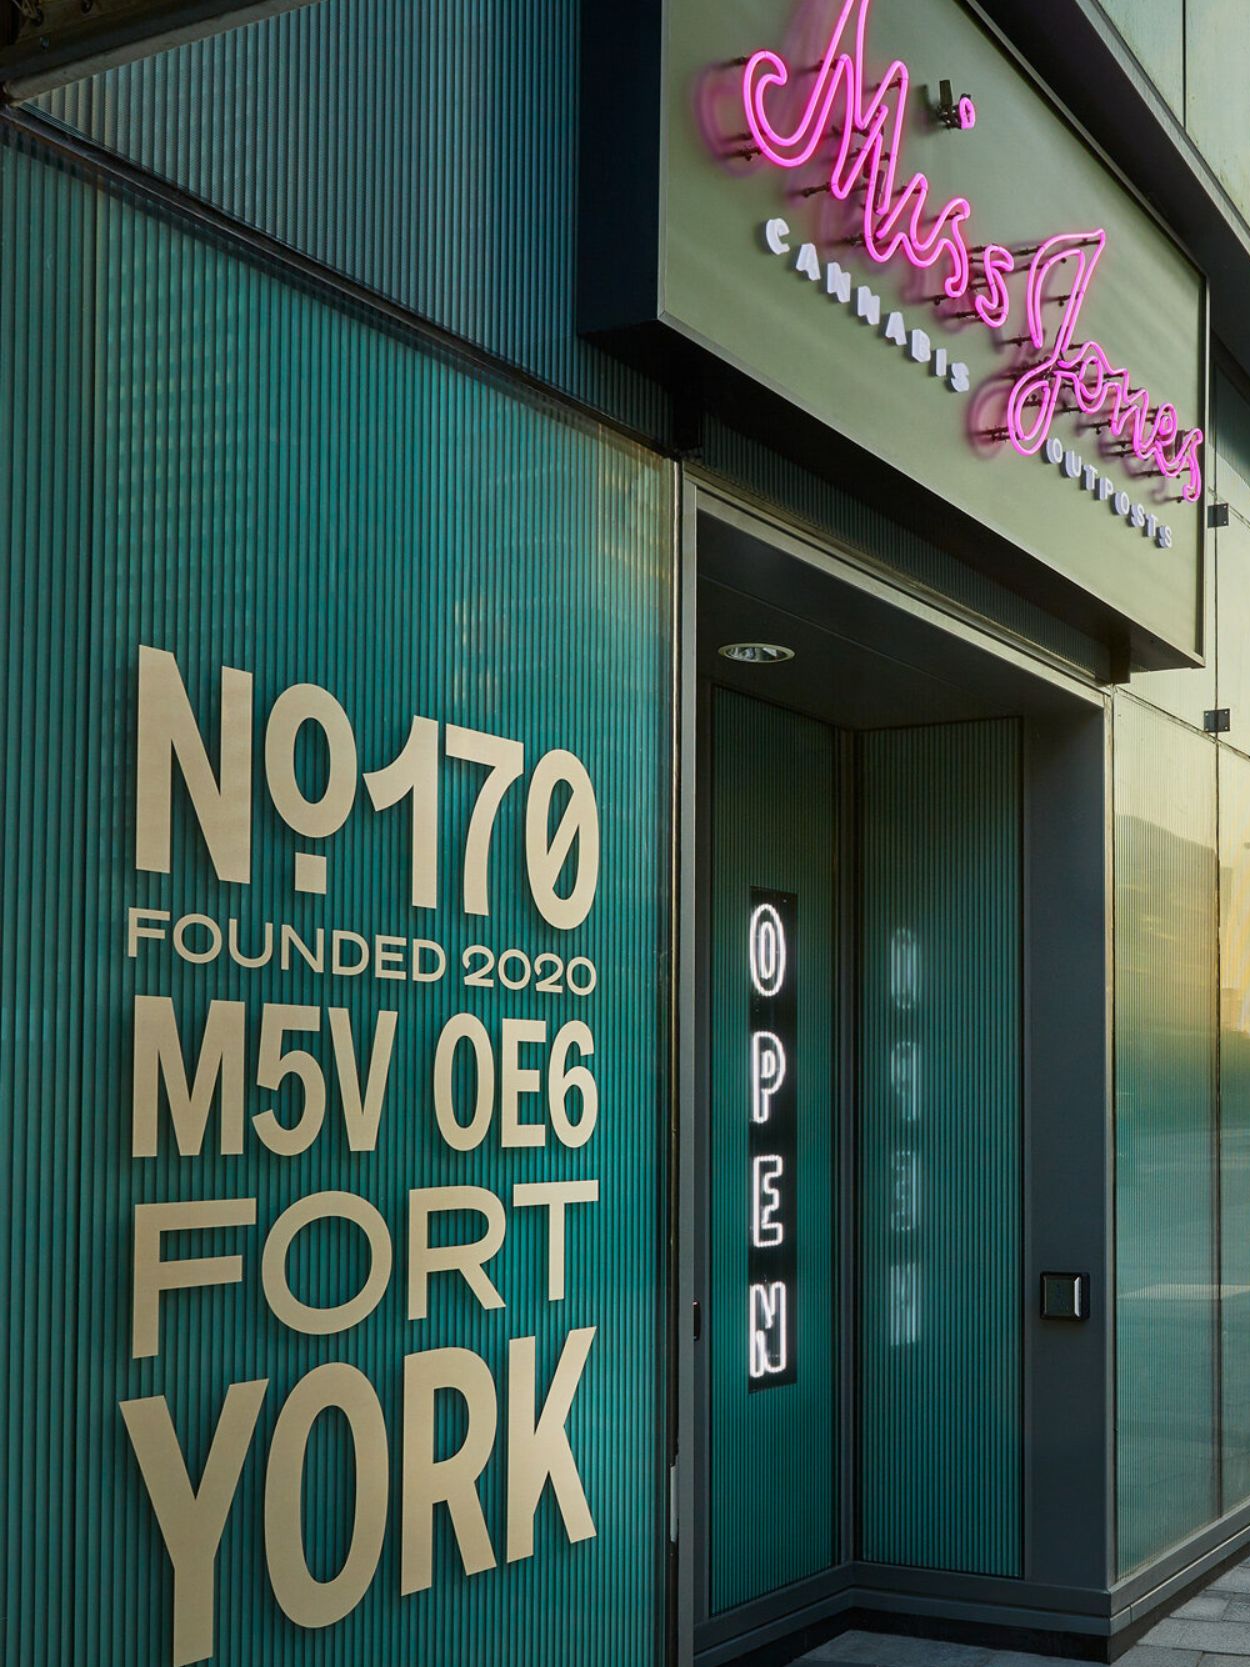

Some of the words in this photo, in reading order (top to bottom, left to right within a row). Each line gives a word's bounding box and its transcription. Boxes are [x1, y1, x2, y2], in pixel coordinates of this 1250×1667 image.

[743, 0, 1013, 327] Miss
[1007, 229, 1204, 503] Jones
[765, 217, 970, 392] CANNABIS
[1045, 438, 1174, 548] OUTPOSTS
[127, 907, 447, 982] FOUNDED
[462, 945, 598, 996] 2020
[131, 995, 398, 1158] M5V
[748, 903, 787, 1378] OPEN
[131, 1179, 600, 1360] FORT
[118, 1326, 599, 1666] YORK
